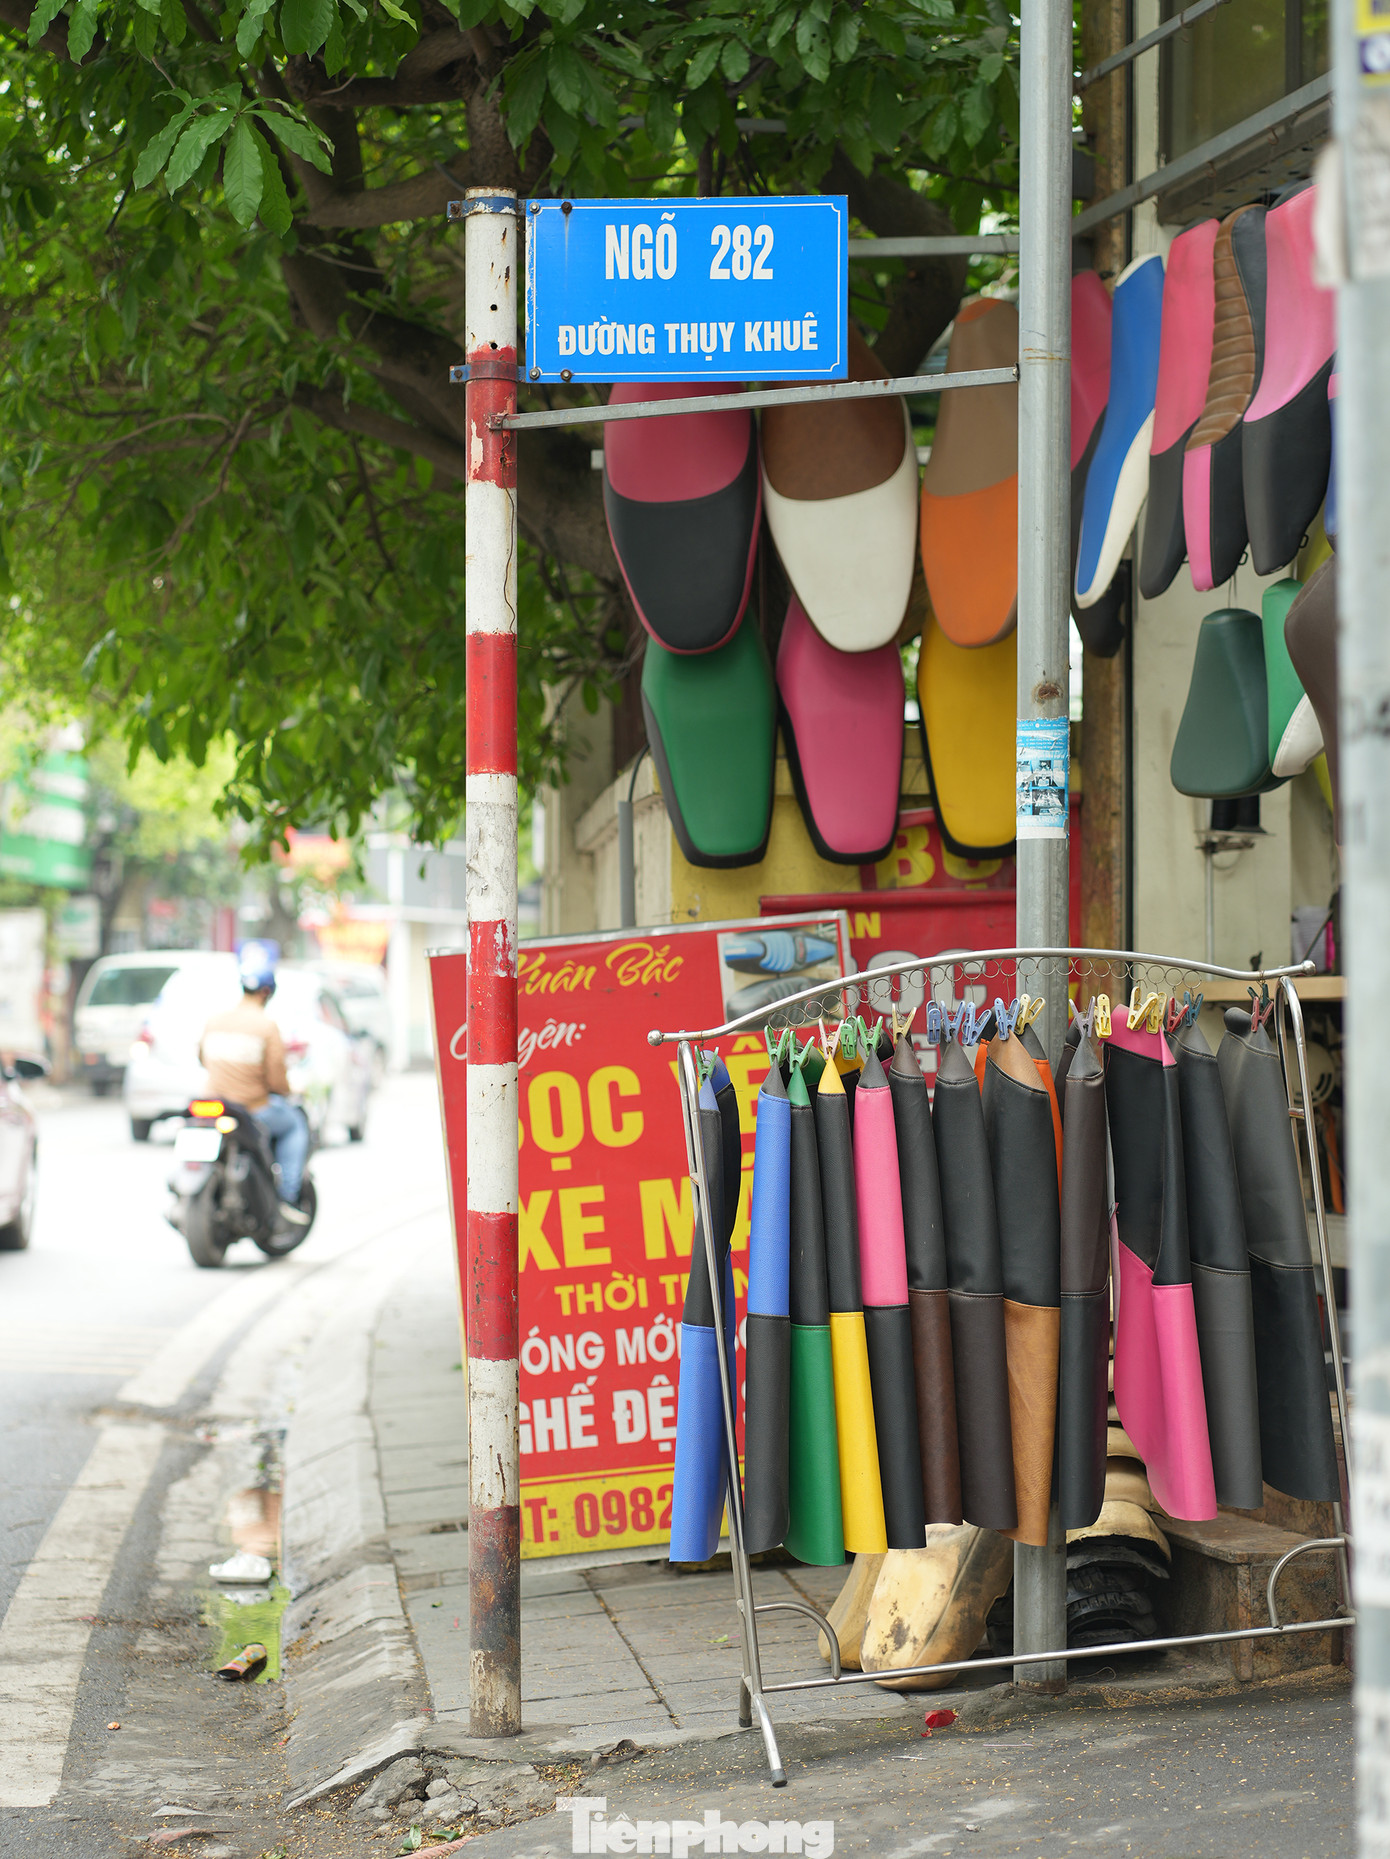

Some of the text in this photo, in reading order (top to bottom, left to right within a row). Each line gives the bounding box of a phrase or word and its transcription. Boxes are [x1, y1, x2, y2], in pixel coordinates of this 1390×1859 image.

[605, 212, 774, 281] NGÕ 282
[557, 311, 819, 361] ĐƯỜNG THỤY KHUÊ
[605, 942, 685, 988] Bắc
[518, 1065, 645, 1172] ỌC
[518, 1184, 613, 1274] XE
[554, 1270, 649, 1317] THỜI
[519, 1325, 606, 1376] ÓNG
[611, 1374, 679, 1453] ĐỆ
[519, 1496, 560, 1544] T:
